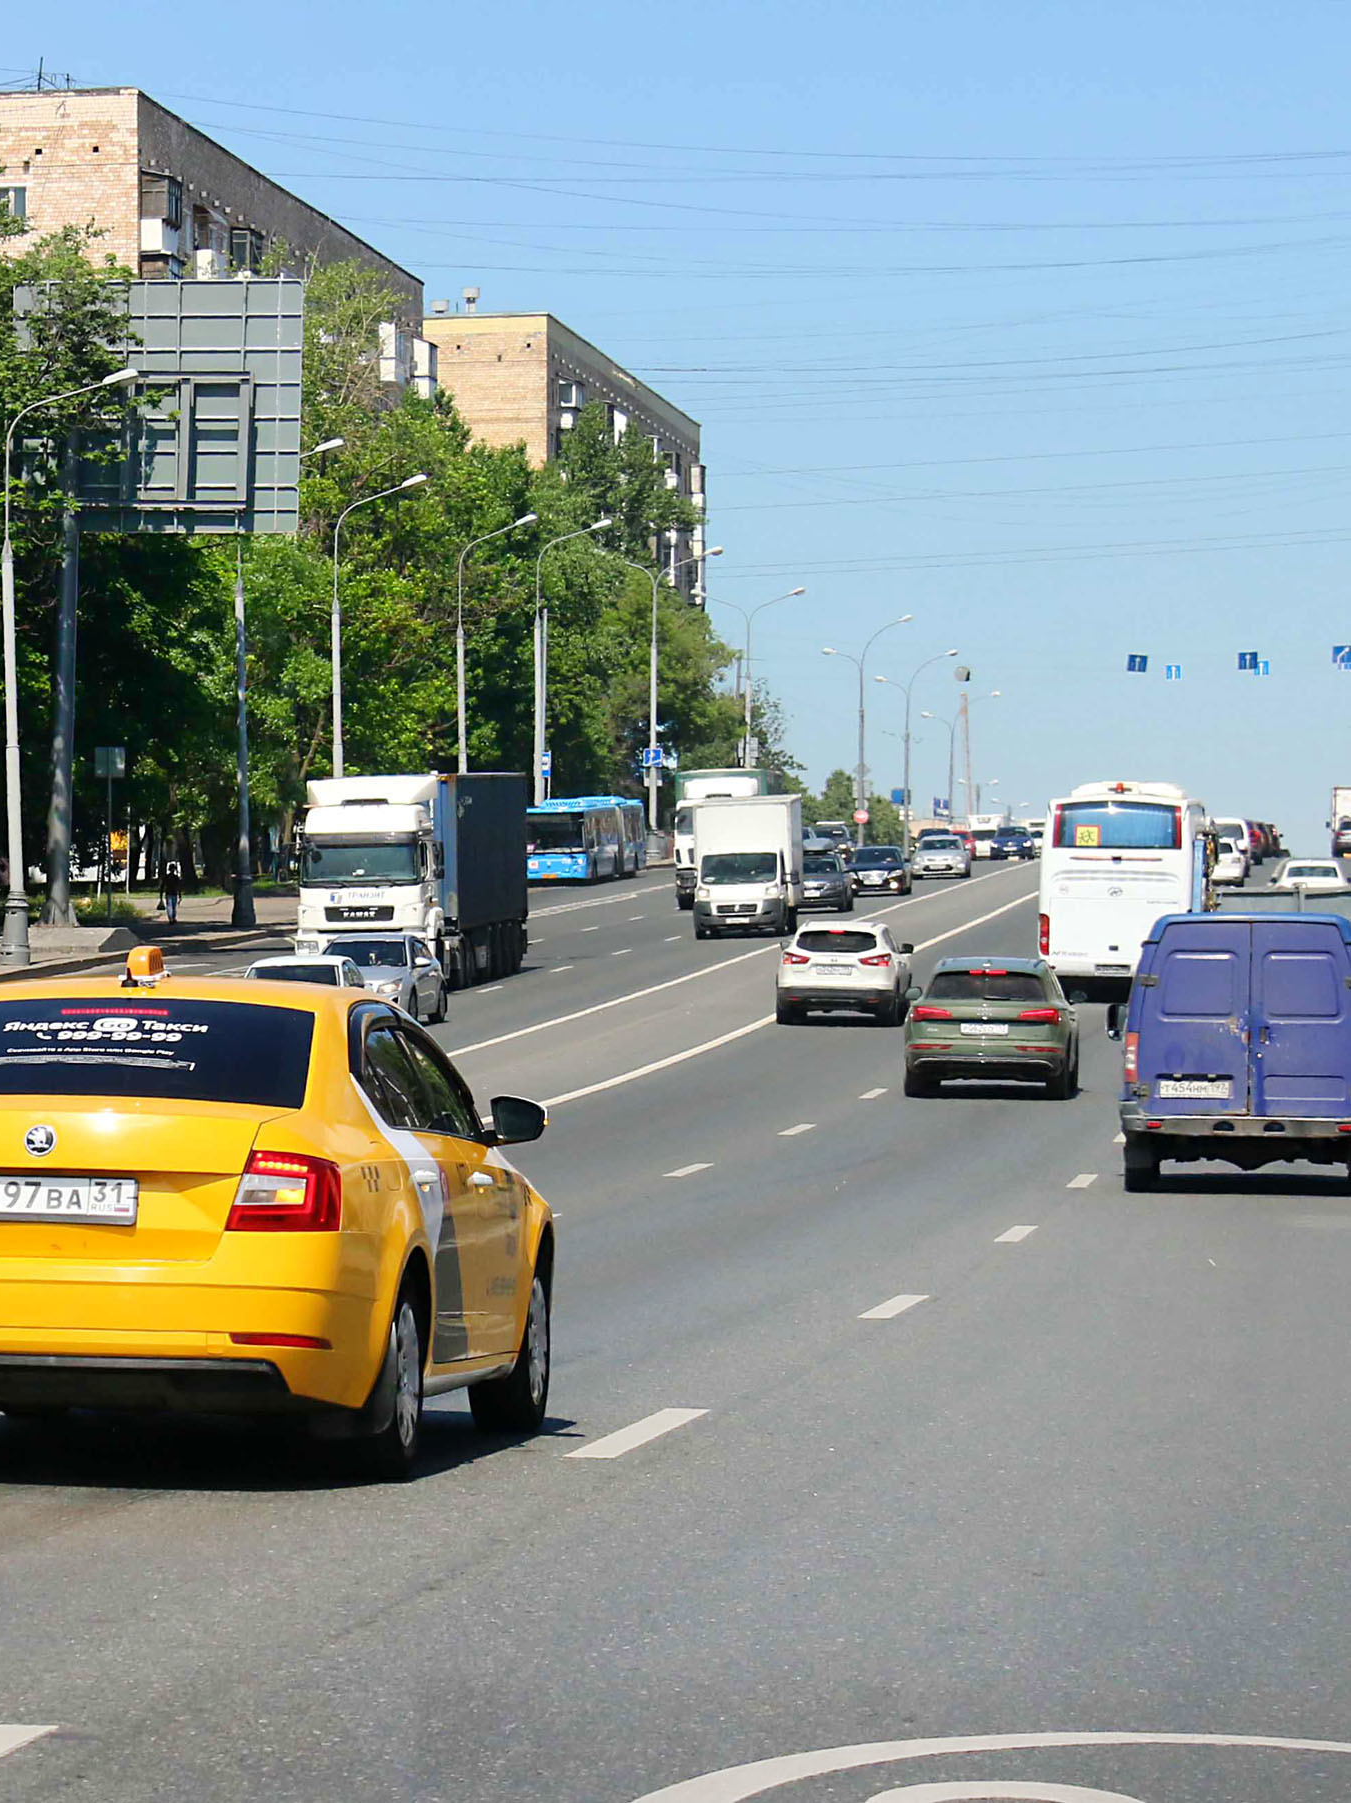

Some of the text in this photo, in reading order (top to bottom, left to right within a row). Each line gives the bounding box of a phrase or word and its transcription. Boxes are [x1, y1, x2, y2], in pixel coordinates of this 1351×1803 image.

[3, 1021, 90, 1032] Яндекс
[142, 1020, 209, 1033] Такси
[57, 1030, 182, 1042] 999-99-99
